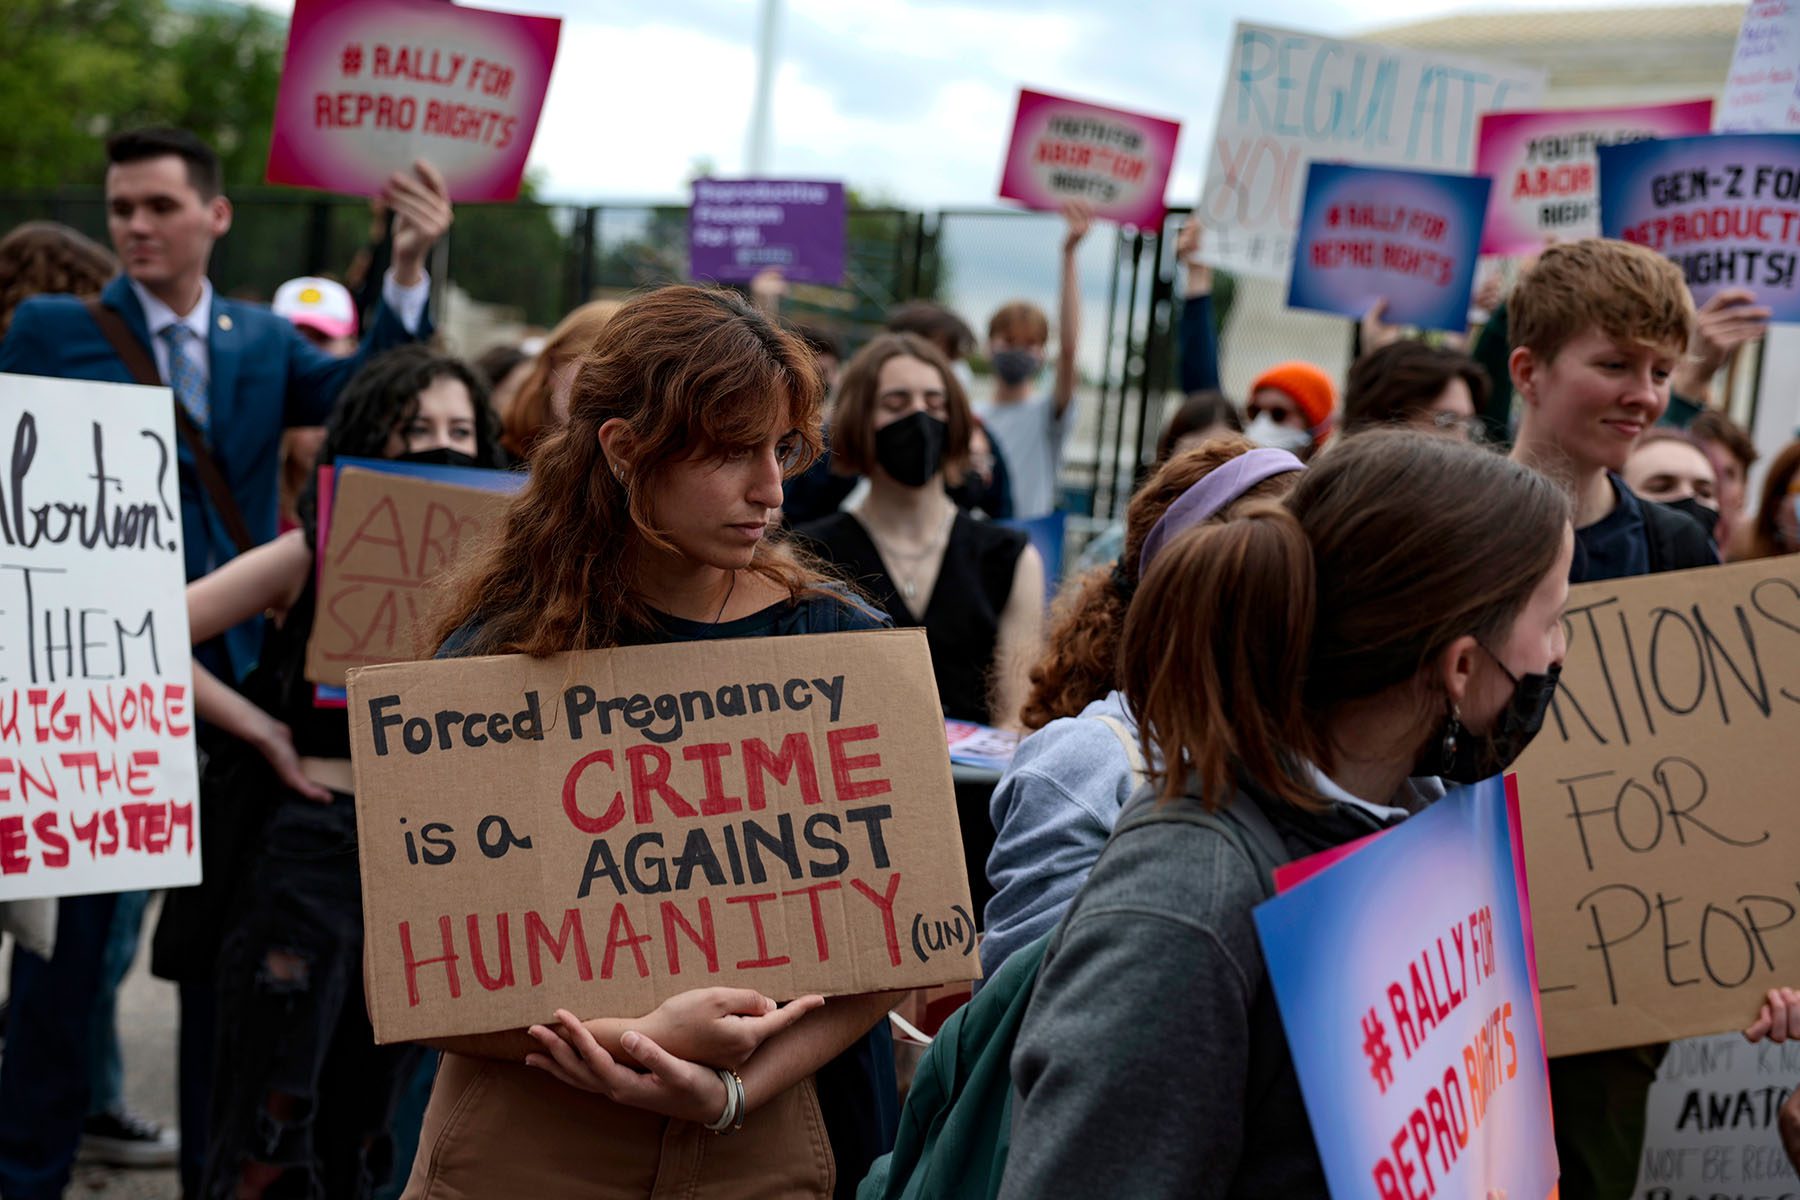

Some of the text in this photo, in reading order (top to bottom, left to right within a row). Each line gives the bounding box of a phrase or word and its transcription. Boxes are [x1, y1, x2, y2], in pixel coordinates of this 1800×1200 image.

[372, 44, 466, 87] RALLY
[466, 54, 517, 100] FOR
[313, 91, 521, 150] REPRO RIGHTS
[1035, 139, 1148, 183] ABORTION
[1512, 162, 1596, 200] ABOR
[1651, 164, 1744, 208] GEN-Z
[1346, 201, 1405, 233] RALLY
[1409, 209, 1447, 243] FOR
[1539, 200, 1596, 228] RIGH
[1310, 239, 1375, 270] REPRO
[1382, 242, 1455, 288] RIGHTS
[1675, 250, 1794, 288] IGHTS!
[0, 563, 162, 684] THEM
[27, 681, 191, 745] IGNORE
[369, 674, 845, 756] Forced Pregnancy
[59, 750, 160, 798] THE
[399, 817, 457, 866] is
[476, 815, 533, 859] a
[561, 723, 893, 835] CRIME
[1557, 756, 1771, 871] FOR
[577, 804, 893, 899] AGAINST
[399, 872, 975, 1008] HUMANITY (UN)
[1576, 882, 1800, 1006] PEOP
[1386, 921, 1468, 1061] RALLY
[1468, 904, 1496, 987] FOR
[1371, 1001, 1518, 1200] REPRO RIGHTS
